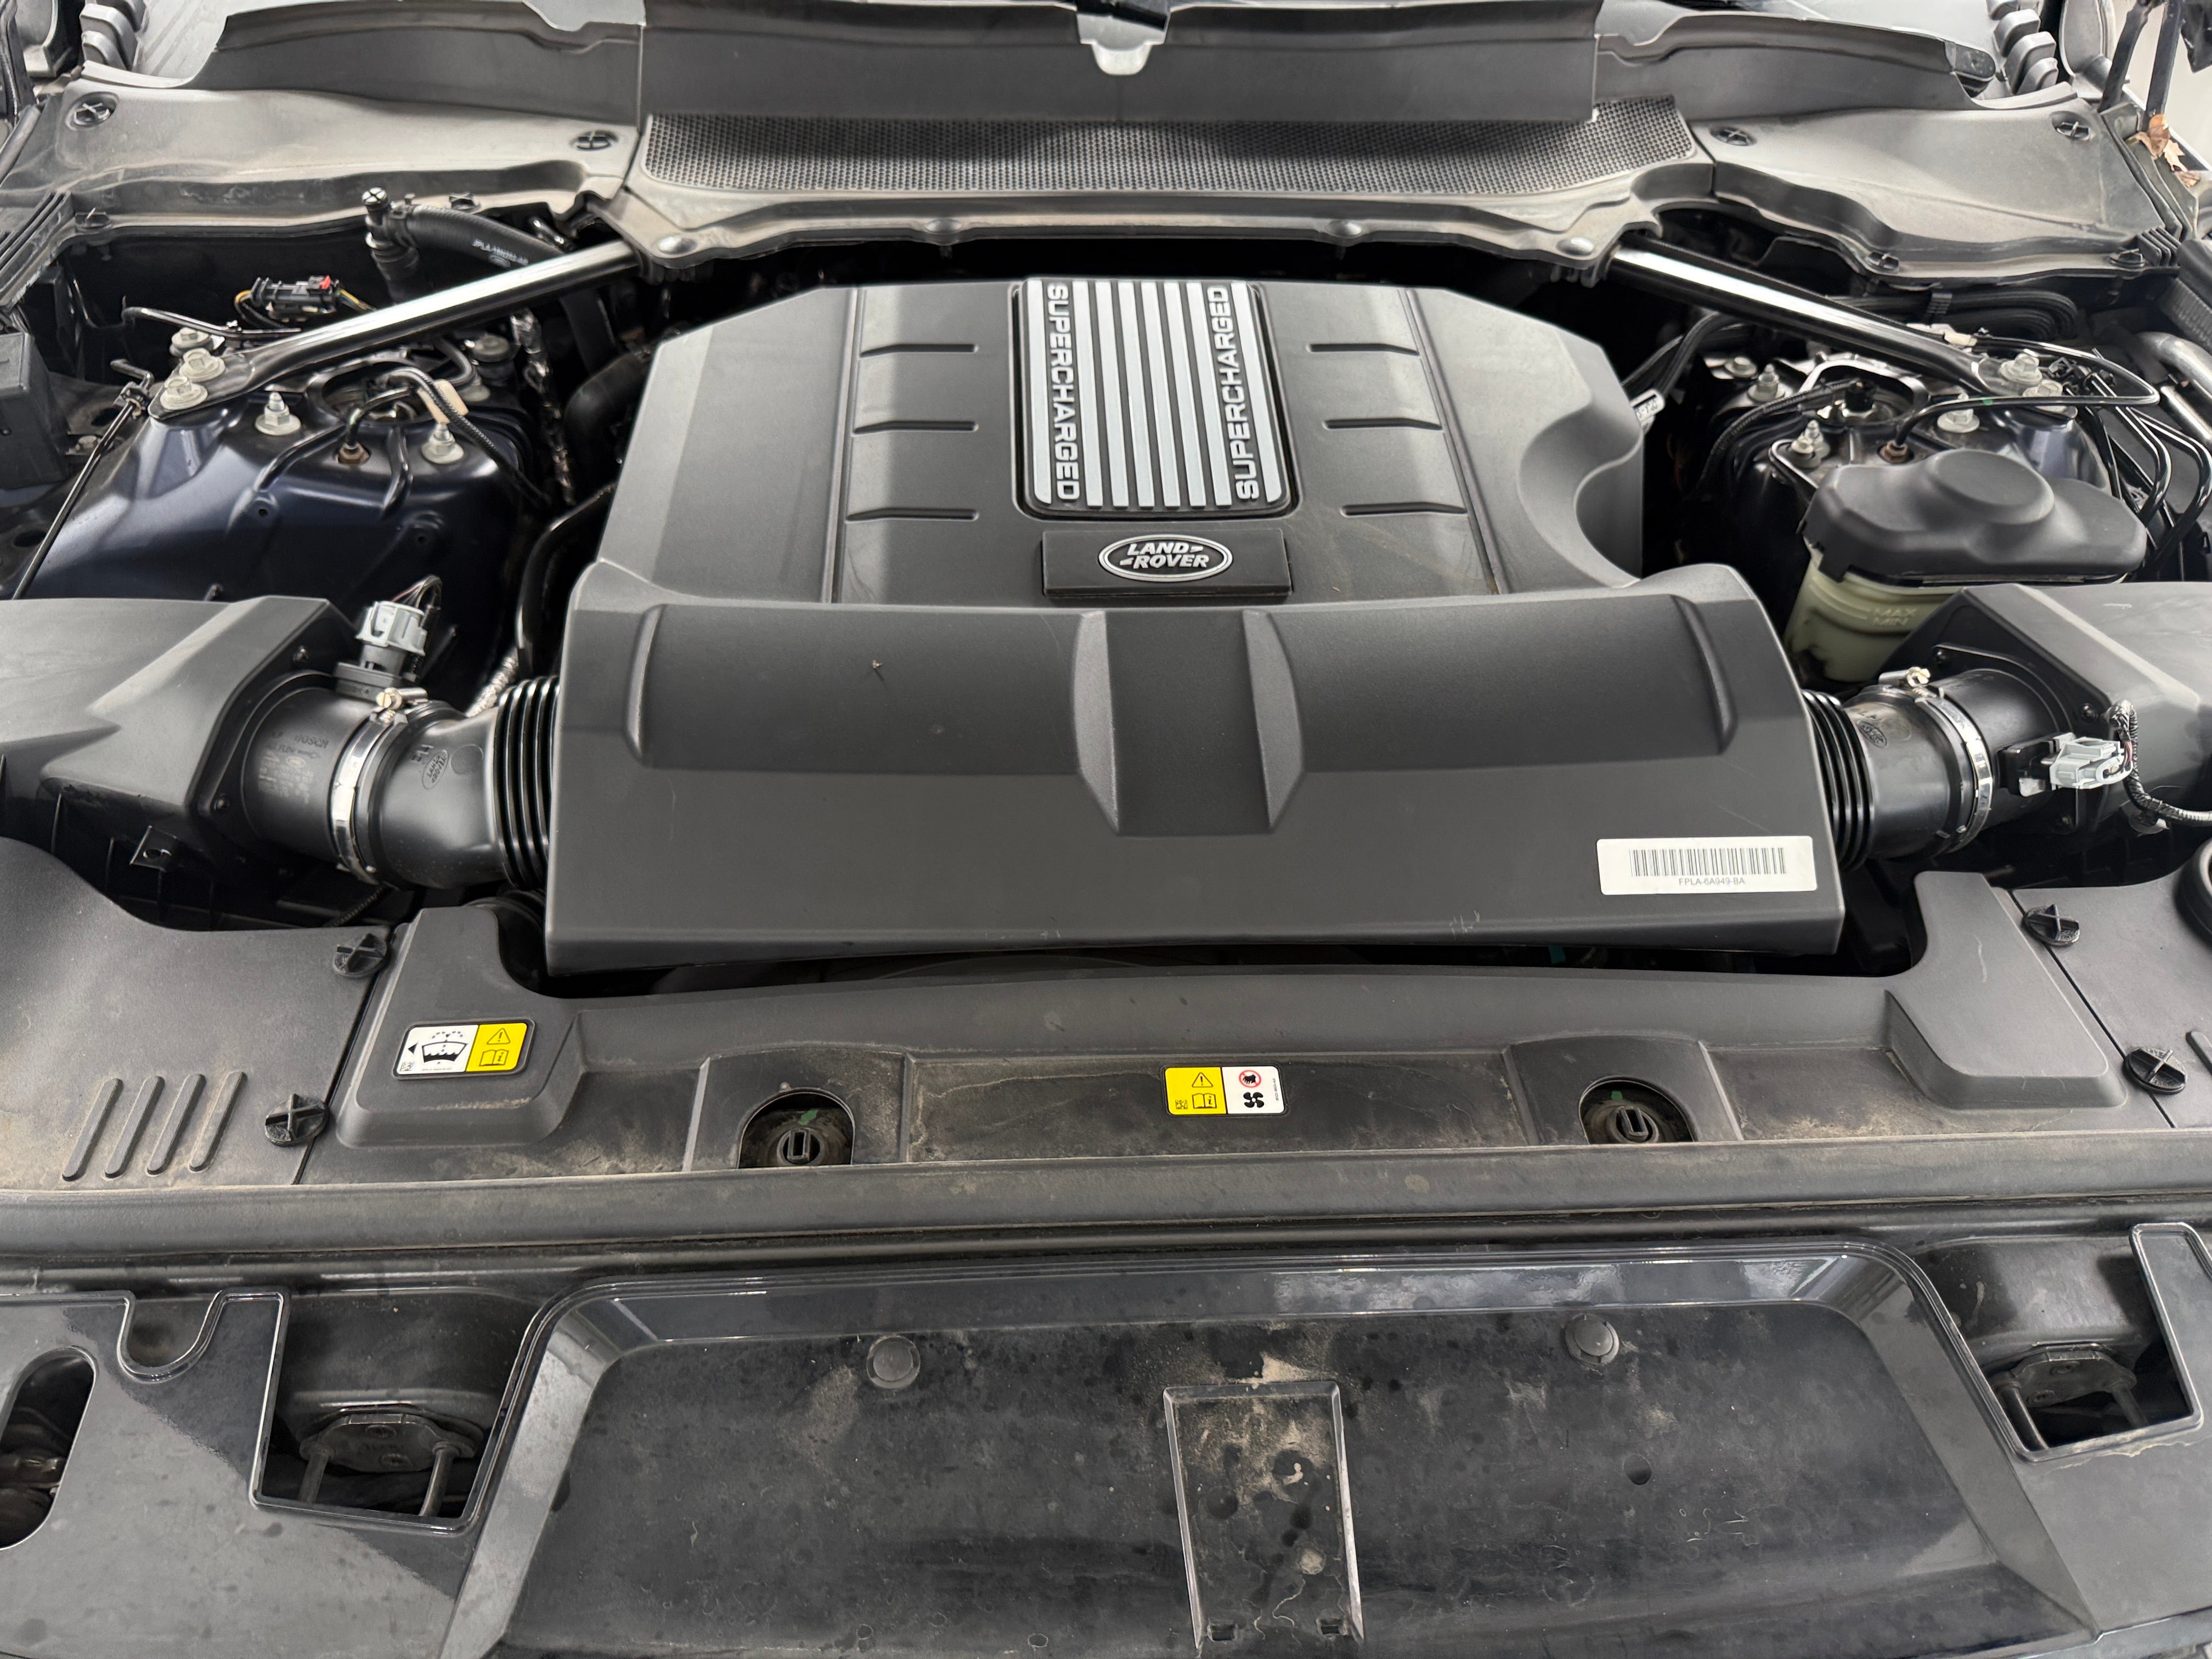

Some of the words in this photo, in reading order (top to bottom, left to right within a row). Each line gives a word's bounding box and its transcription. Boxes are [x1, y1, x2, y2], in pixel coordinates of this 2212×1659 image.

[1047, 283, 1080, 501] SUPERCHARGED
[1207, 286, 1259, 500] SUPERCHARGED
[1127, 541, 1189, 555] LAND
[1133, 554, 1209, 569] ROVER
[1875, 608, 1917, 617] MAX
[1679, 877, 1745, 886] FPLA-6A949-BA
